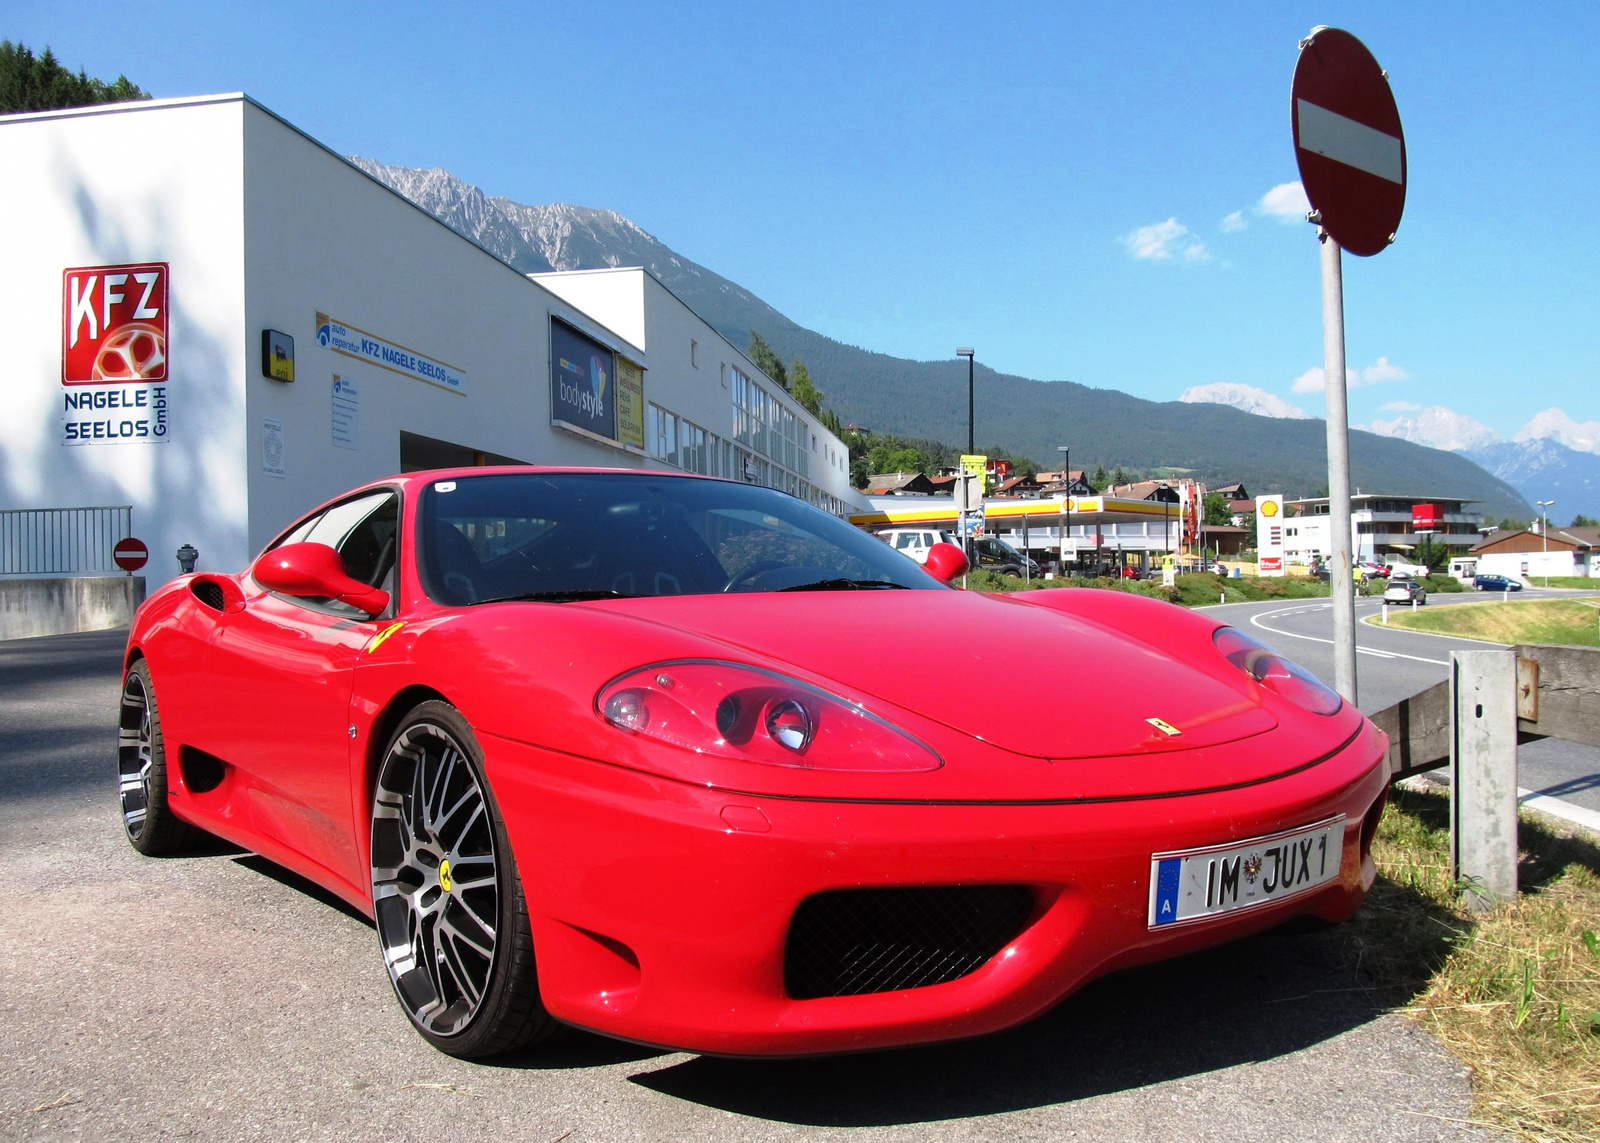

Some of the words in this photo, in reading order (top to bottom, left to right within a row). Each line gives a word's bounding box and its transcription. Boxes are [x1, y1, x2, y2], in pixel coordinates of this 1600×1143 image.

[70, 272, 161, 351] KFZ
[331, 324, 347, 337] auto
[331, 337, 360, 353] reparatur
[361, 338, 380, 357] KFZ
[382, 347, 416, 371] NAGELE
[417, 360, 446, 382] SEELOS
[275, 367, 289, 380] eni
[619, 362, 636, 379] FITNESS
[560, 374, 604, 419] bodystyle
[619, 377, 641, 395] WELLNESS
[65, 389, 148, 411] NAGELE
[153, 387, 166, 437] GmbH
[65, 419, 149, 440] SEELOS
[1205, 855, 1241, 908] IM
[1263, 837, 1313, 893] JUX
[1318, 833, 1328, 876] 1
[1161, 899, 1172, 914] A
